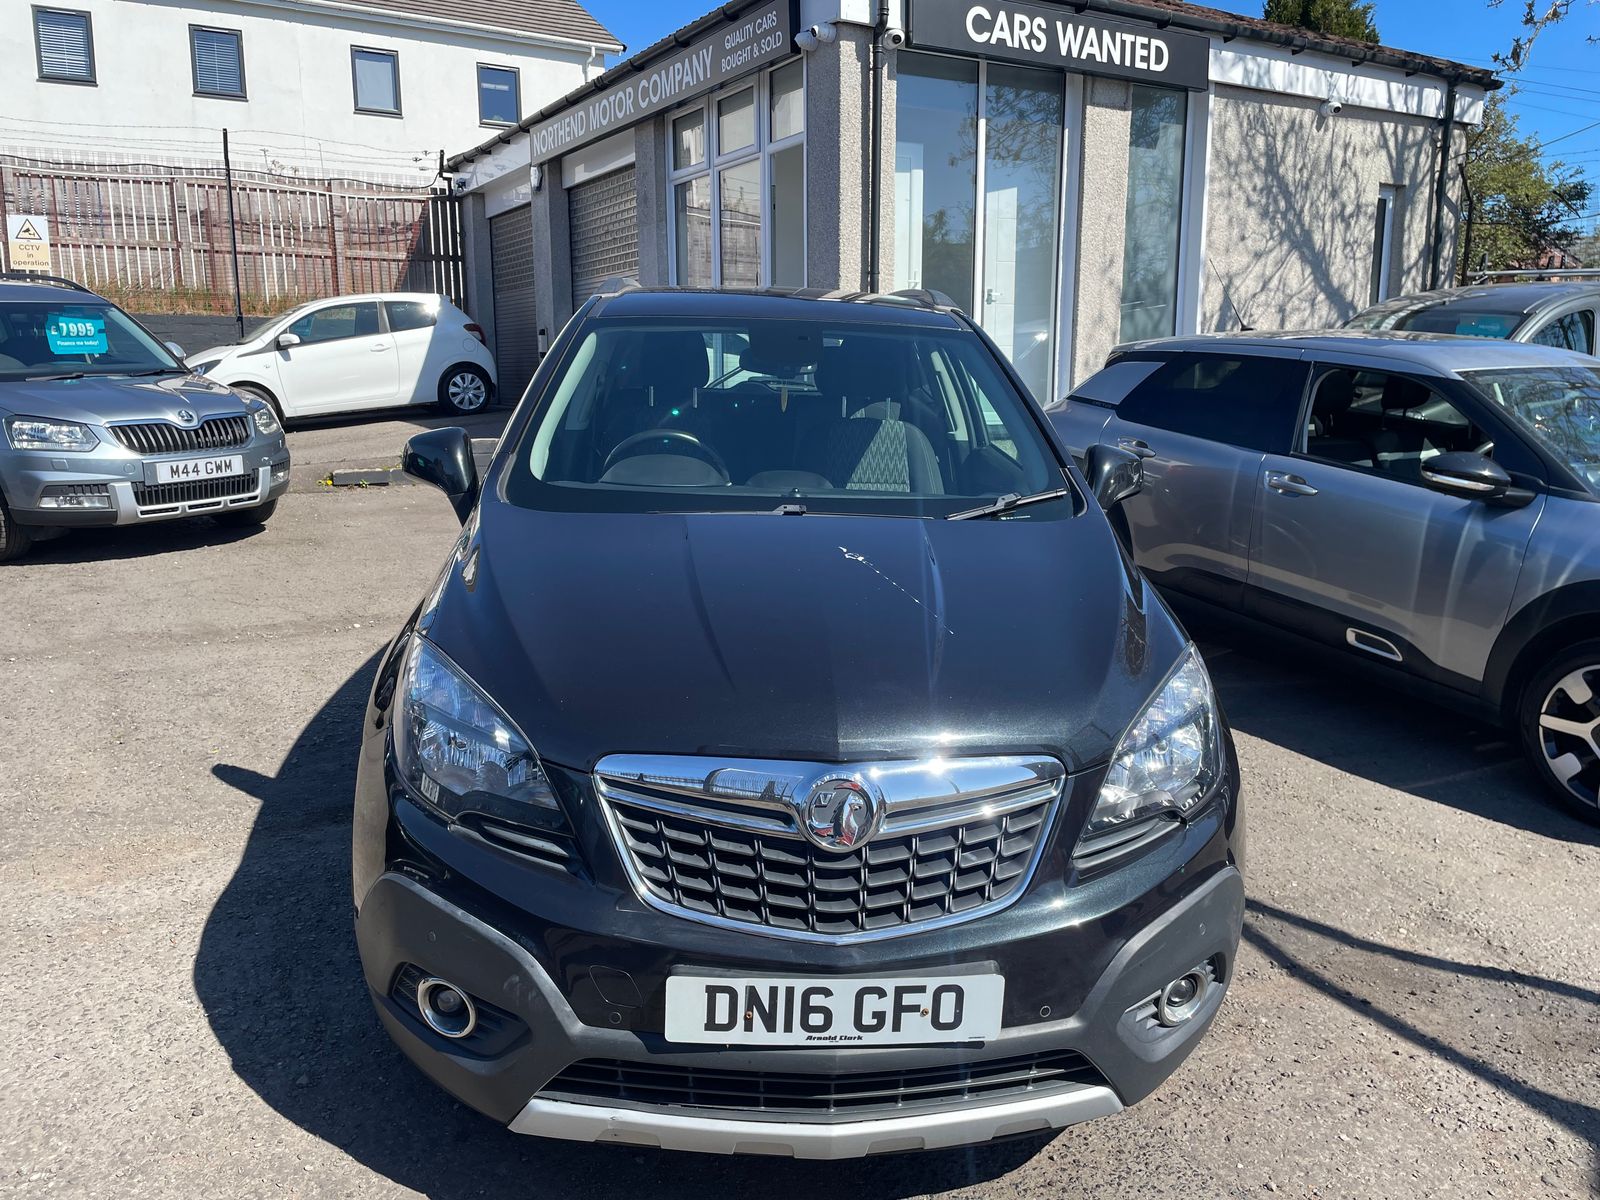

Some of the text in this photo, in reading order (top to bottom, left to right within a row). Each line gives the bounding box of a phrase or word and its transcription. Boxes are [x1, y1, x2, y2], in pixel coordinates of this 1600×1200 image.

[721, 31, 783, 73] BOUGHT & SOLD
[724, 10, 777, 50] QUALITY CARS
[966, 6, 1169, 72] CARS WANTED
[533, 45, 713, 157] NORTHEND MOTOR COMPANY
[170, 459, 233, 479] M44 GWM
[704, 984, 965, 1034] DN16 GFO
